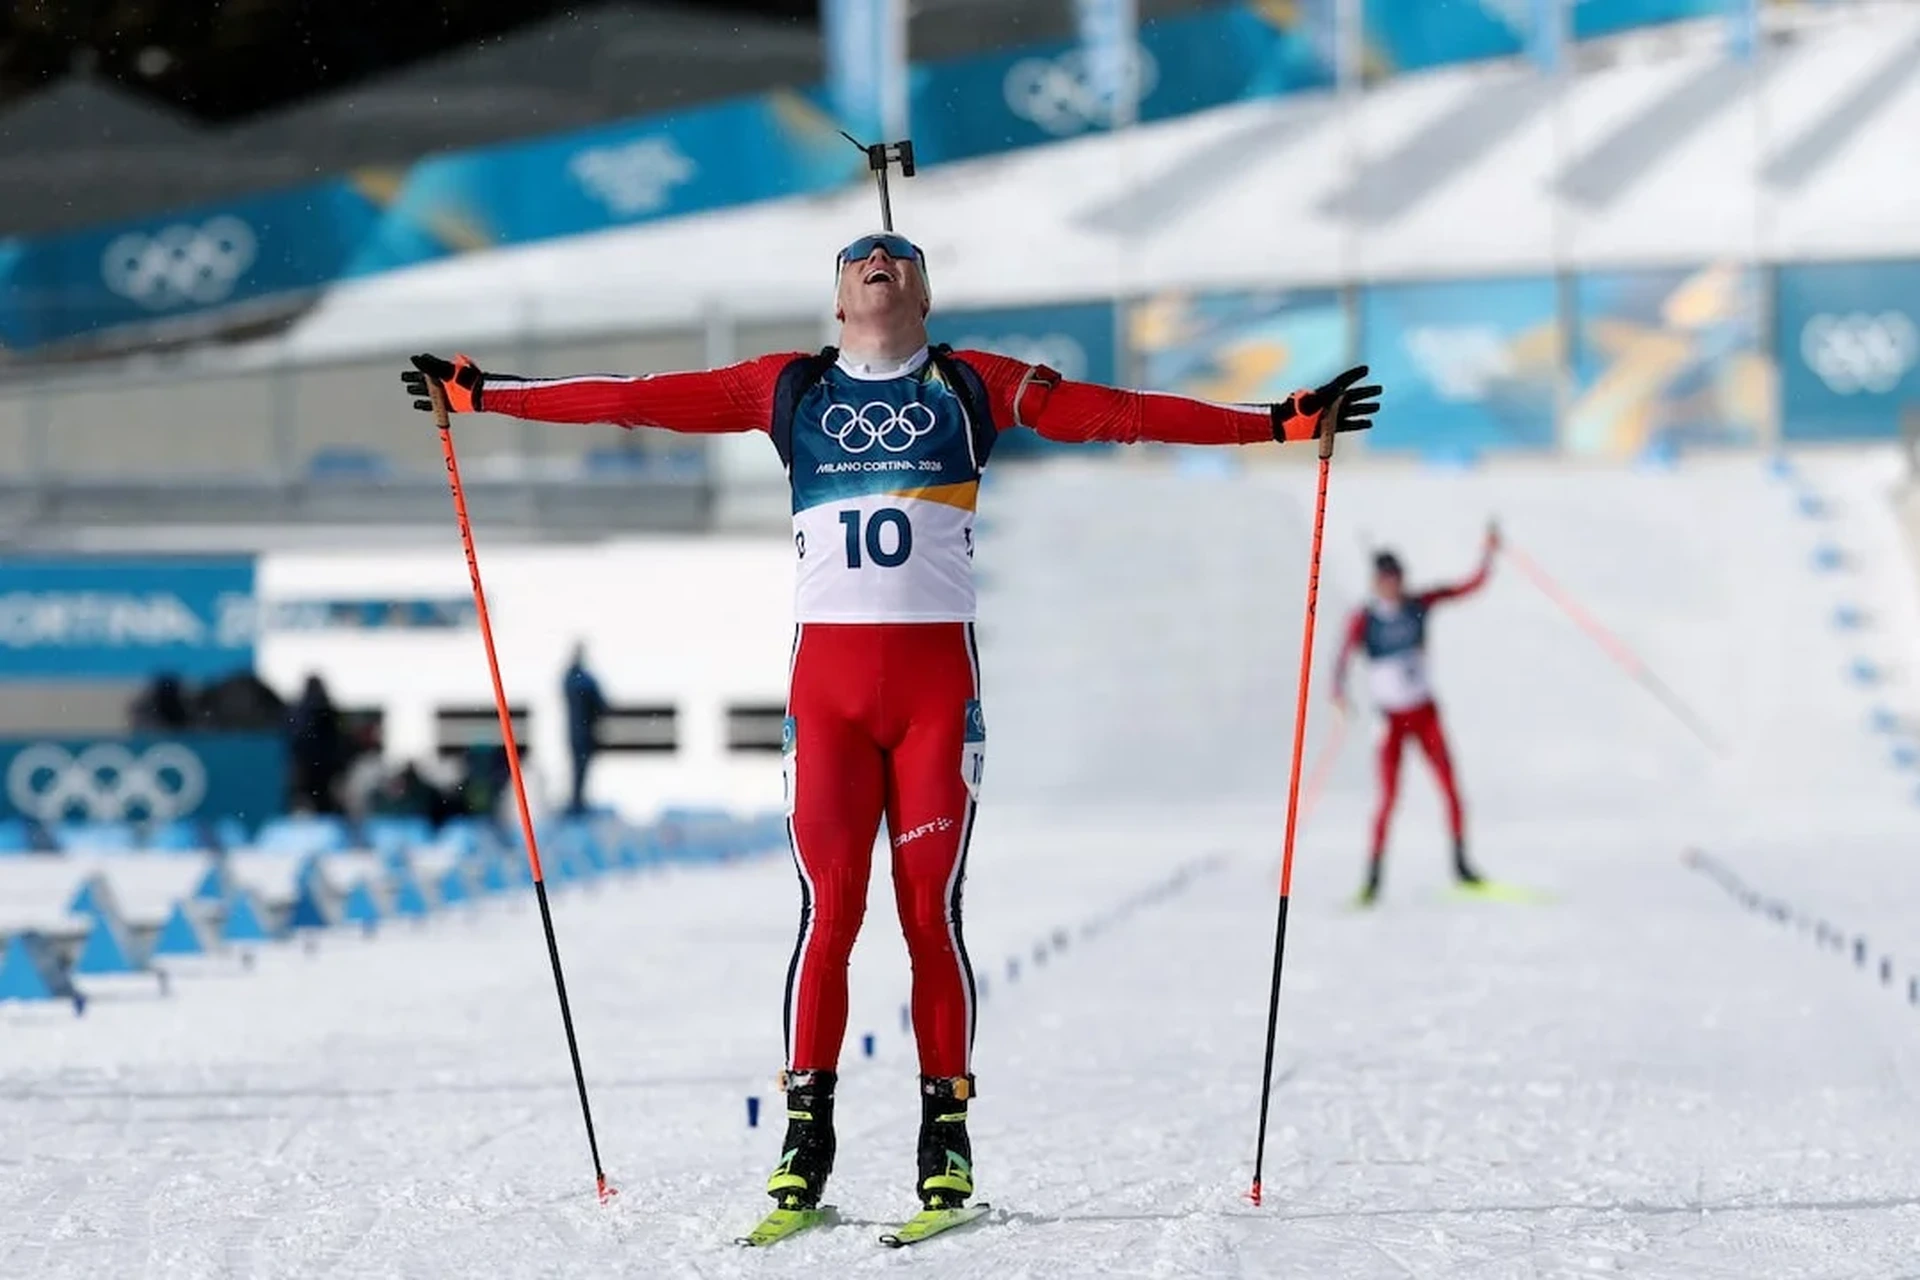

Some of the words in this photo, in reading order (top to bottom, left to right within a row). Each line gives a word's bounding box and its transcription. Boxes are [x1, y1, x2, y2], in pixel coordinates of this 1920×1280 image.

[816, 463, 860, 474] MILANO
[863, 461, 916, 472] CORTINA
[918, 461, 942, 471] 2026
[839, 508, 913, 569] 10
[895, 821, 936, 848] CRAFT
